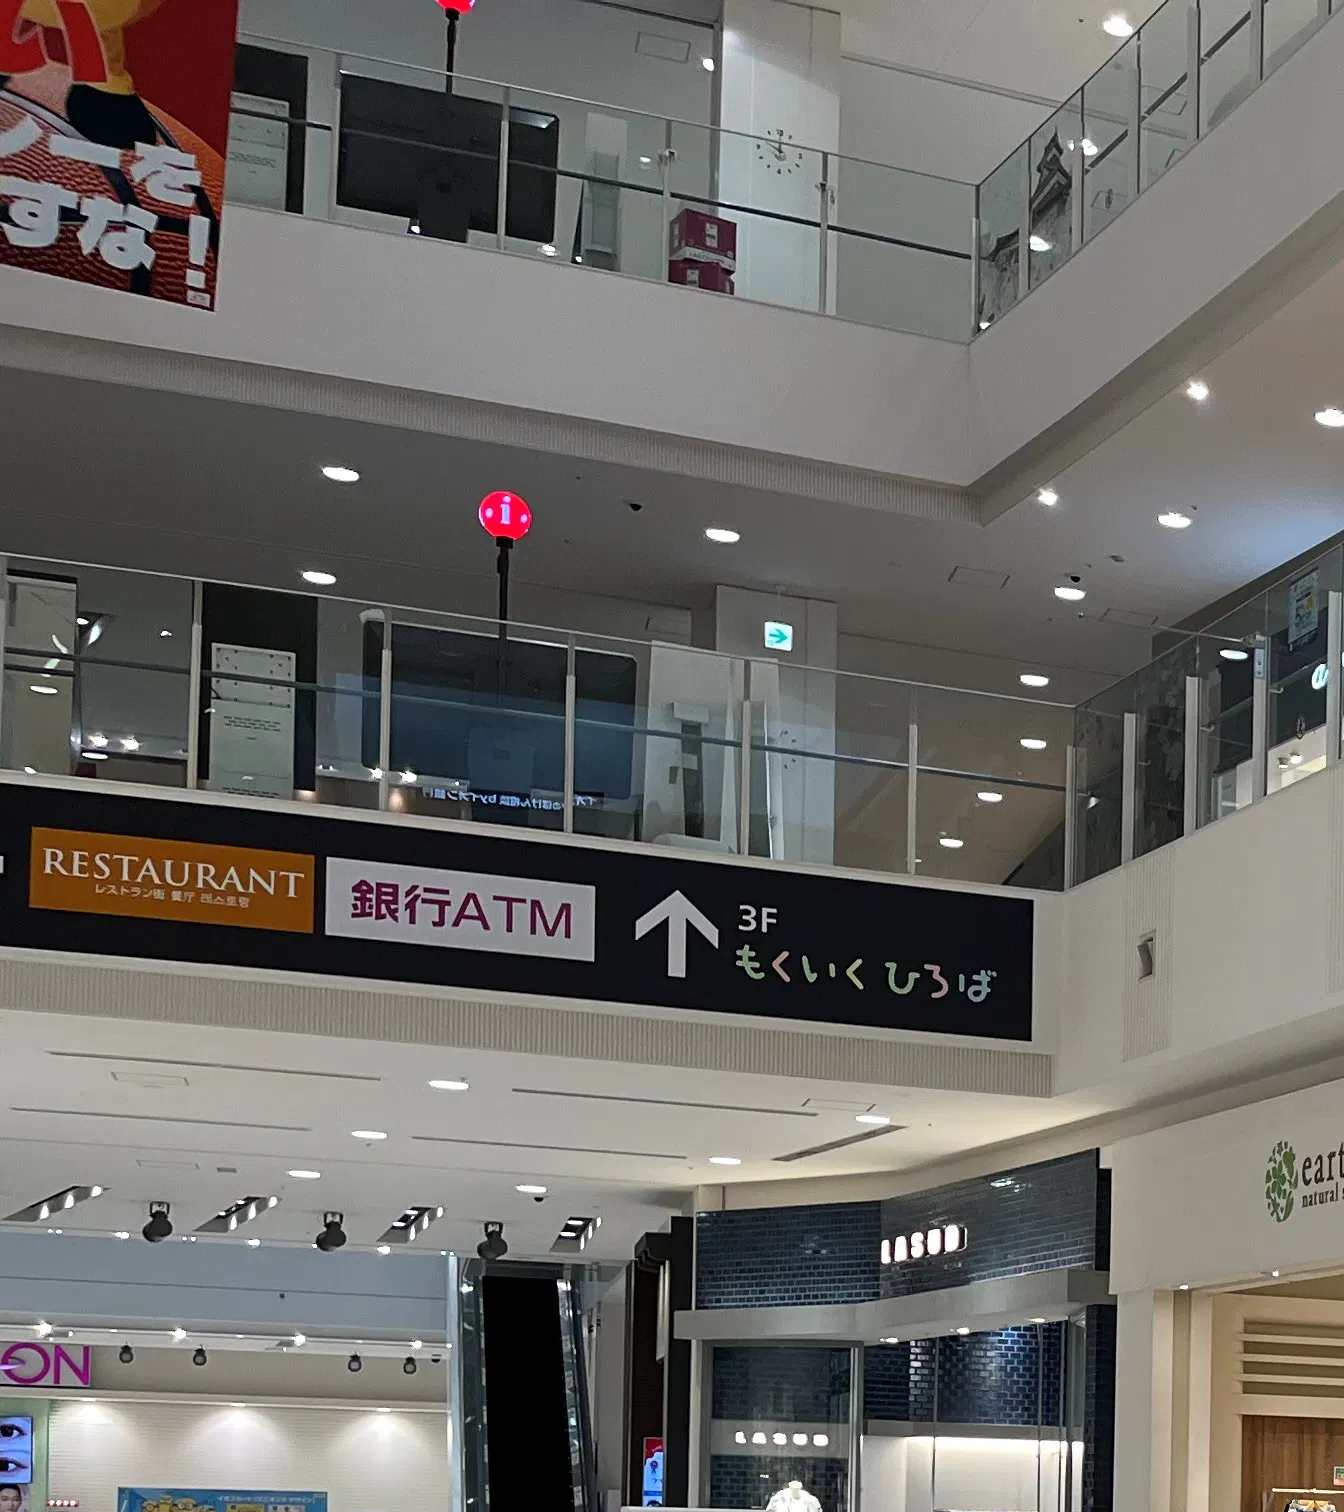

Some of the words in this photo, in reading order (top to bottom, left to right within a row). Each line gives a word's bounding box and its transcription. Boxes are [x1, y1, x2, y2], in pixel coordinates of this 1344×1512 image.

[42, 847, 305, 898] RESTAURANT
[350, 878, 572, 941] 銀行ATM
[738, 904, 778, 933] 3F
[884, 962, 998, 1003] ひろば
[1301, 1182, 1339, 1209] natural
